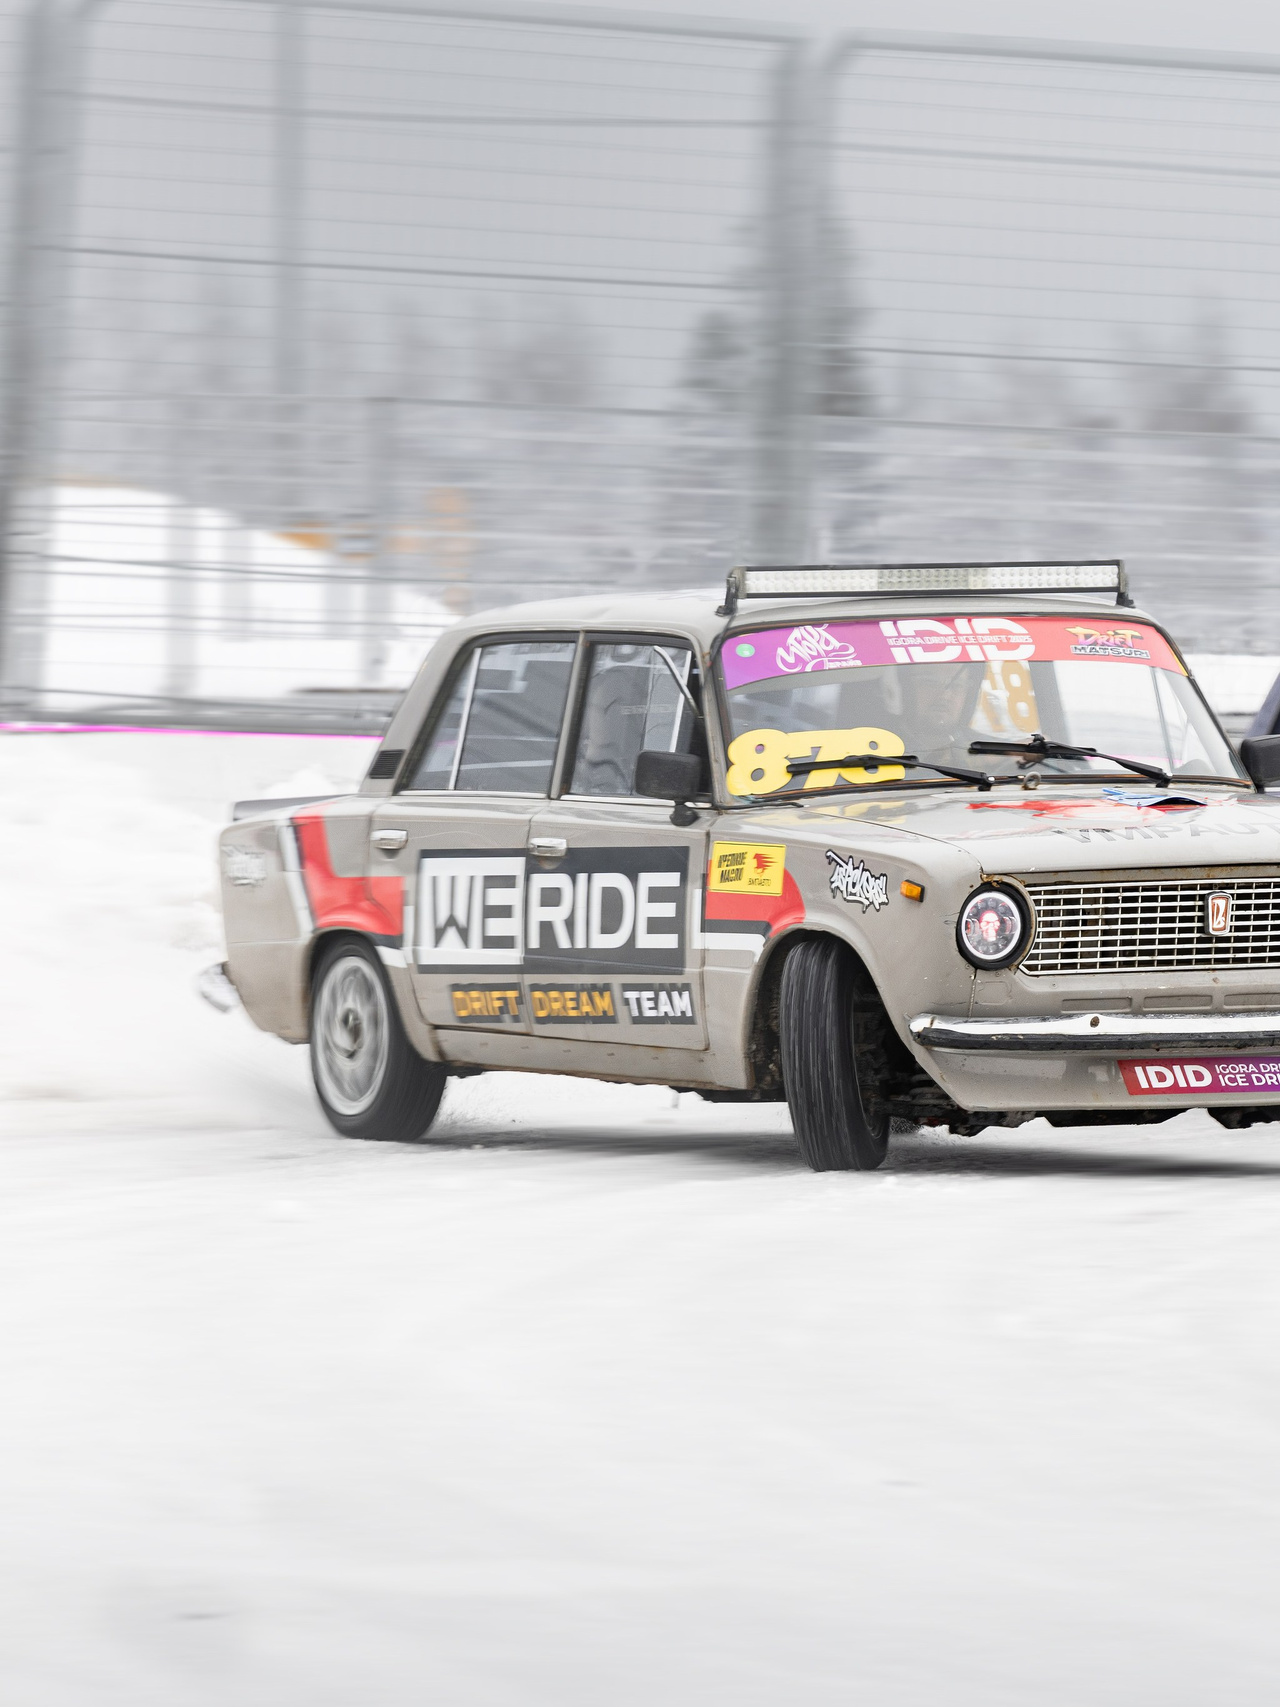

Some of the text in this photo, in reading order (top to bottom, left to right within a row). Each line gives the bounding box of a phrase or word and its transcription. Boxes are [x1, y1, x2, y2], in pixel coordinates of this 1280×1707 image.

[887, 636, 925, 646] IGORA
[923, 635, 960, 646] DRIVE
[958, 635, 978, 644] ICE
[976, 635, 1008, 644] DRIFT
[1070, 645, 1150, 659] MATSURI
[726, 726, 906, 796] 878
[452, 990, 693, 1018] DRIFT DREAM TEAM
[1215, 1064, 1257, 1074] IGORA
[1134, 1064, 1213, 1089] IDID
[1218, 1073, 1249, 1087] ICE
